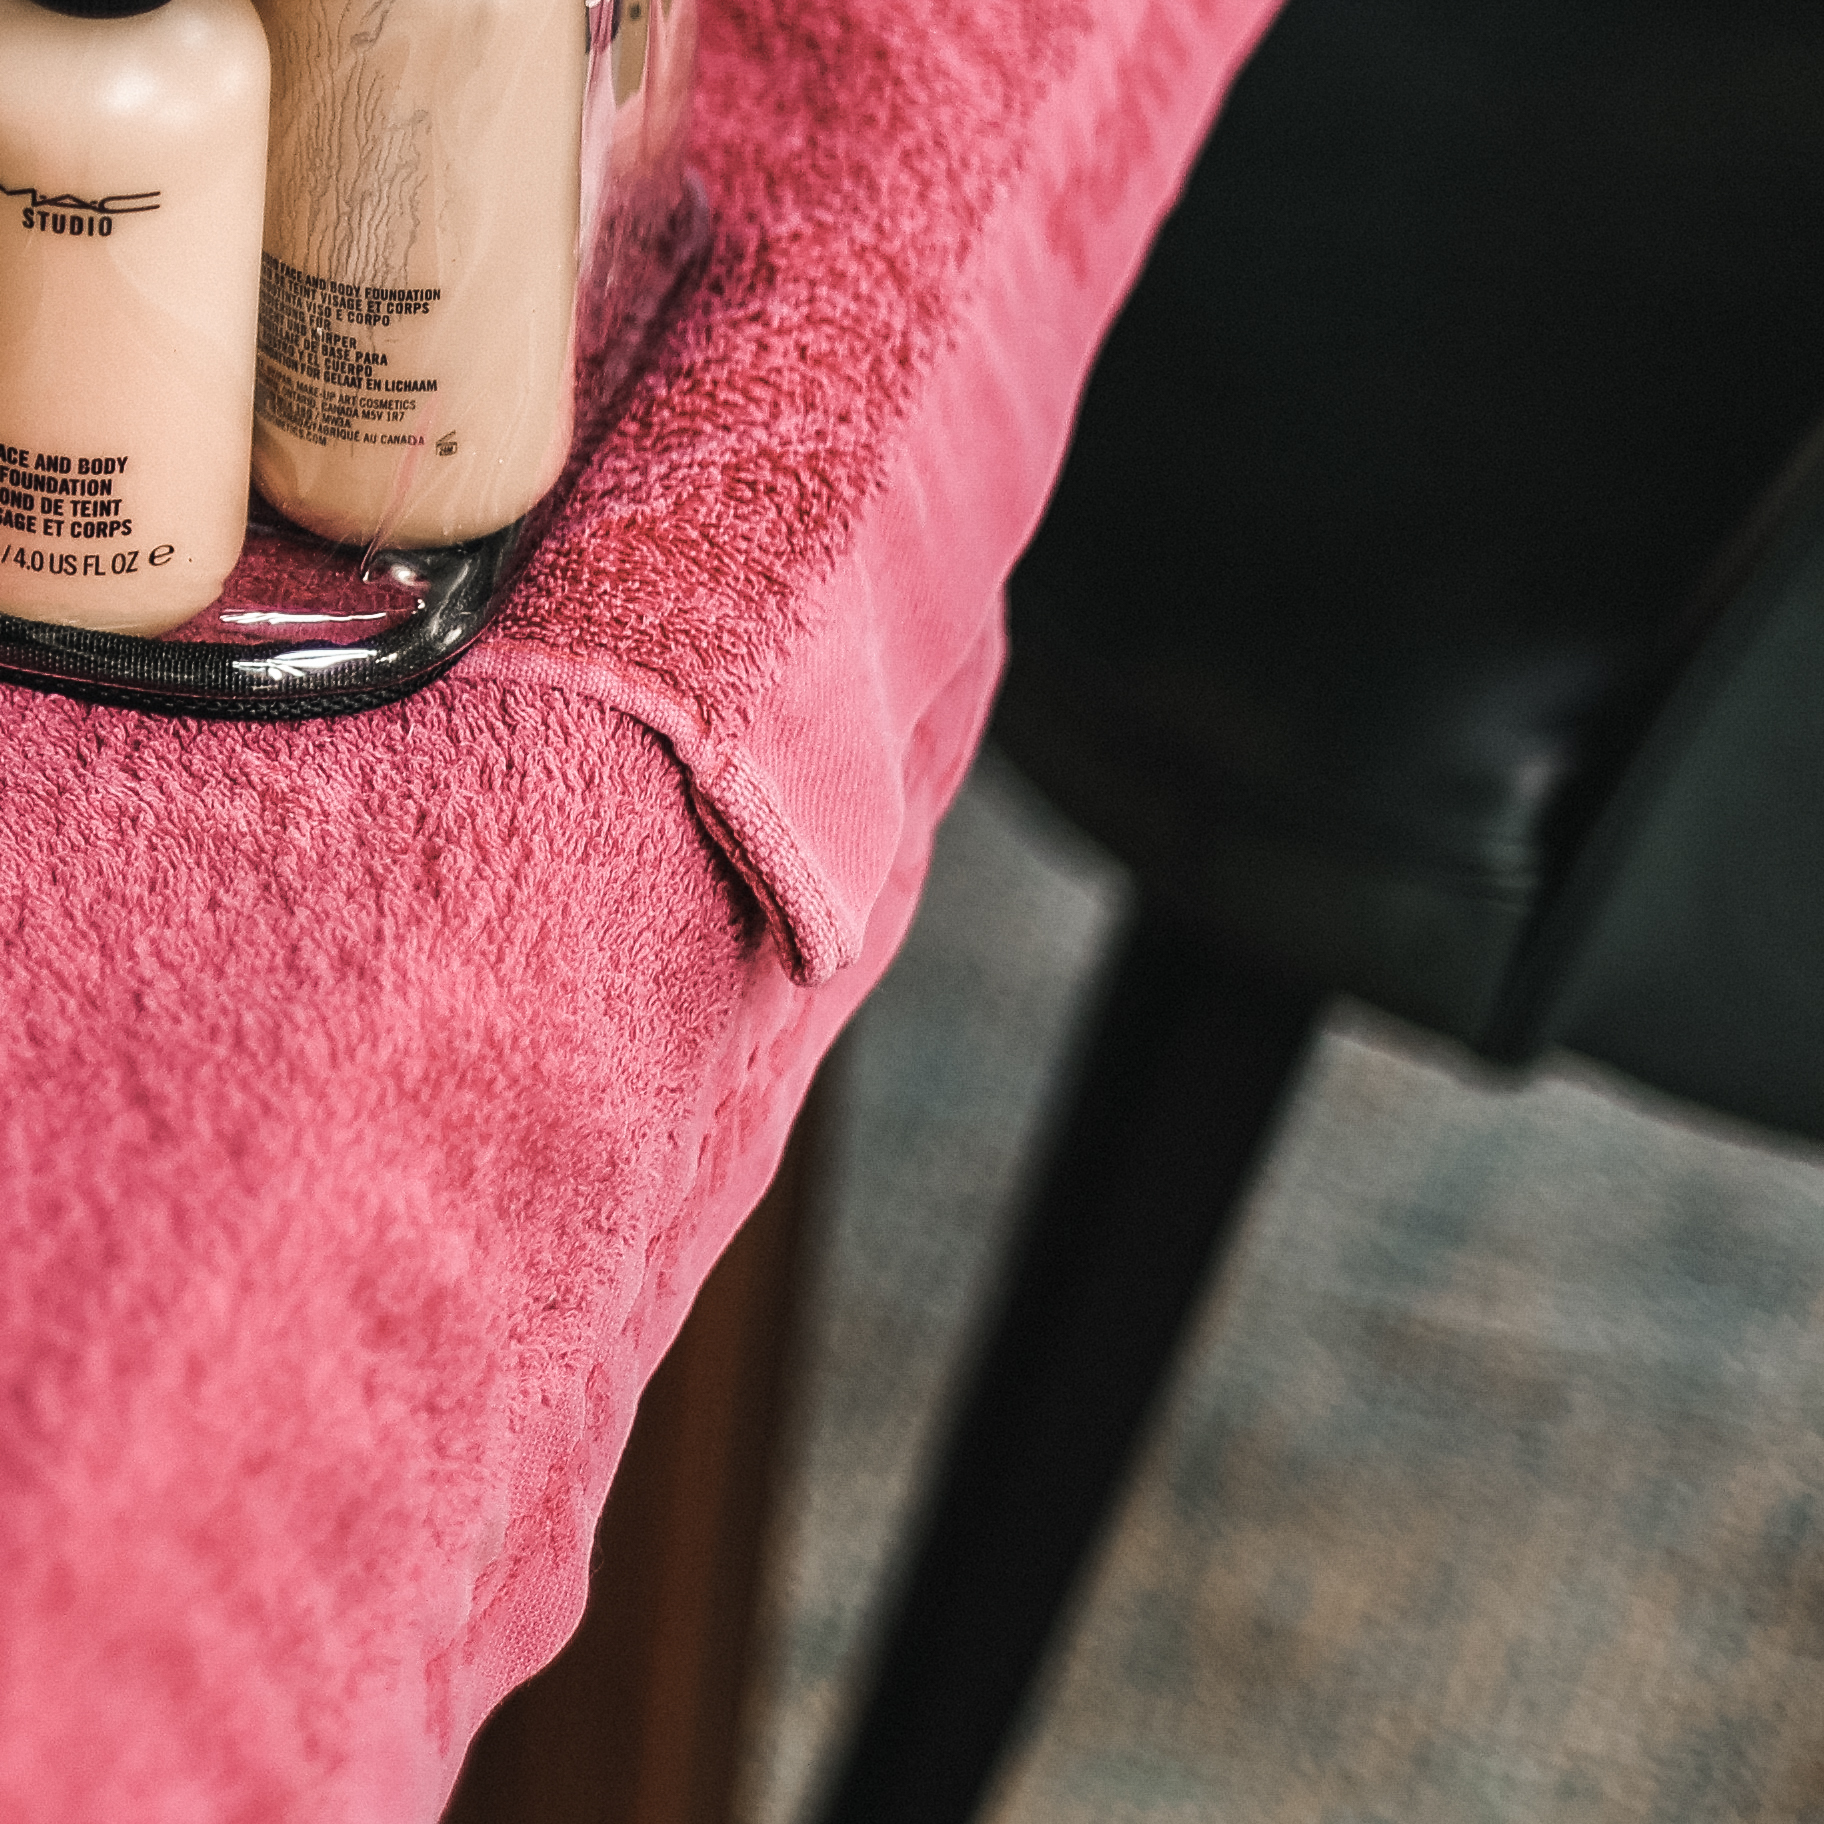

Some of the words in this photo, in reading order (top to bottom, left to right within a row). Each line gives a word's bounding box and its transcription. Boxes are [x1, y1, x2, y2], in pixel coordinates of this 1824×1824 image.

[21, 206, 113, 237] STUDIO
[304, 274, 327, 291] AND
[329, 280, 361, 299] BODY
[364, 287, 441, 303] FOUNDATION
[305, 299, 333, 319] VISO
[335, 308, 344, 323] E
[347, 312, 391, 328] CORPO
[319, 291, 363, 312] VISAGE
[366, 300, 382, 314] ET
[386, 301, 431, 315] CORPS
[321, 344, 351, 362] BASE
[354, 350, 388, 367] PARA
[323, 357, 373, 378] CUERPO
[323, 370, 363, 390] GELAAT
[365, 377, 382, 392] EN
[384, 379, 438, 393] LICHAAM
[337, 392, 358, 406] ART
[359, 397, 416, 411] COSMETICS
[363, 431, 378, 445] AU
[380, 434, 425, 446] CANADA
[33, 452, 72, 476] AND
[77, 454, 129, 476] BODY
[40, 495, 65, 517] DE
[69, 497, 123, 518] TEINT
[42, 518, 65, 538] ET
[69, 518, 133, 539] CORPS
[12, 547, 45, 573] 4.0
[48, 552, 78, 576] US
[82, 553, 107, 577] FL
[110, 550, 140, 575] OZ
